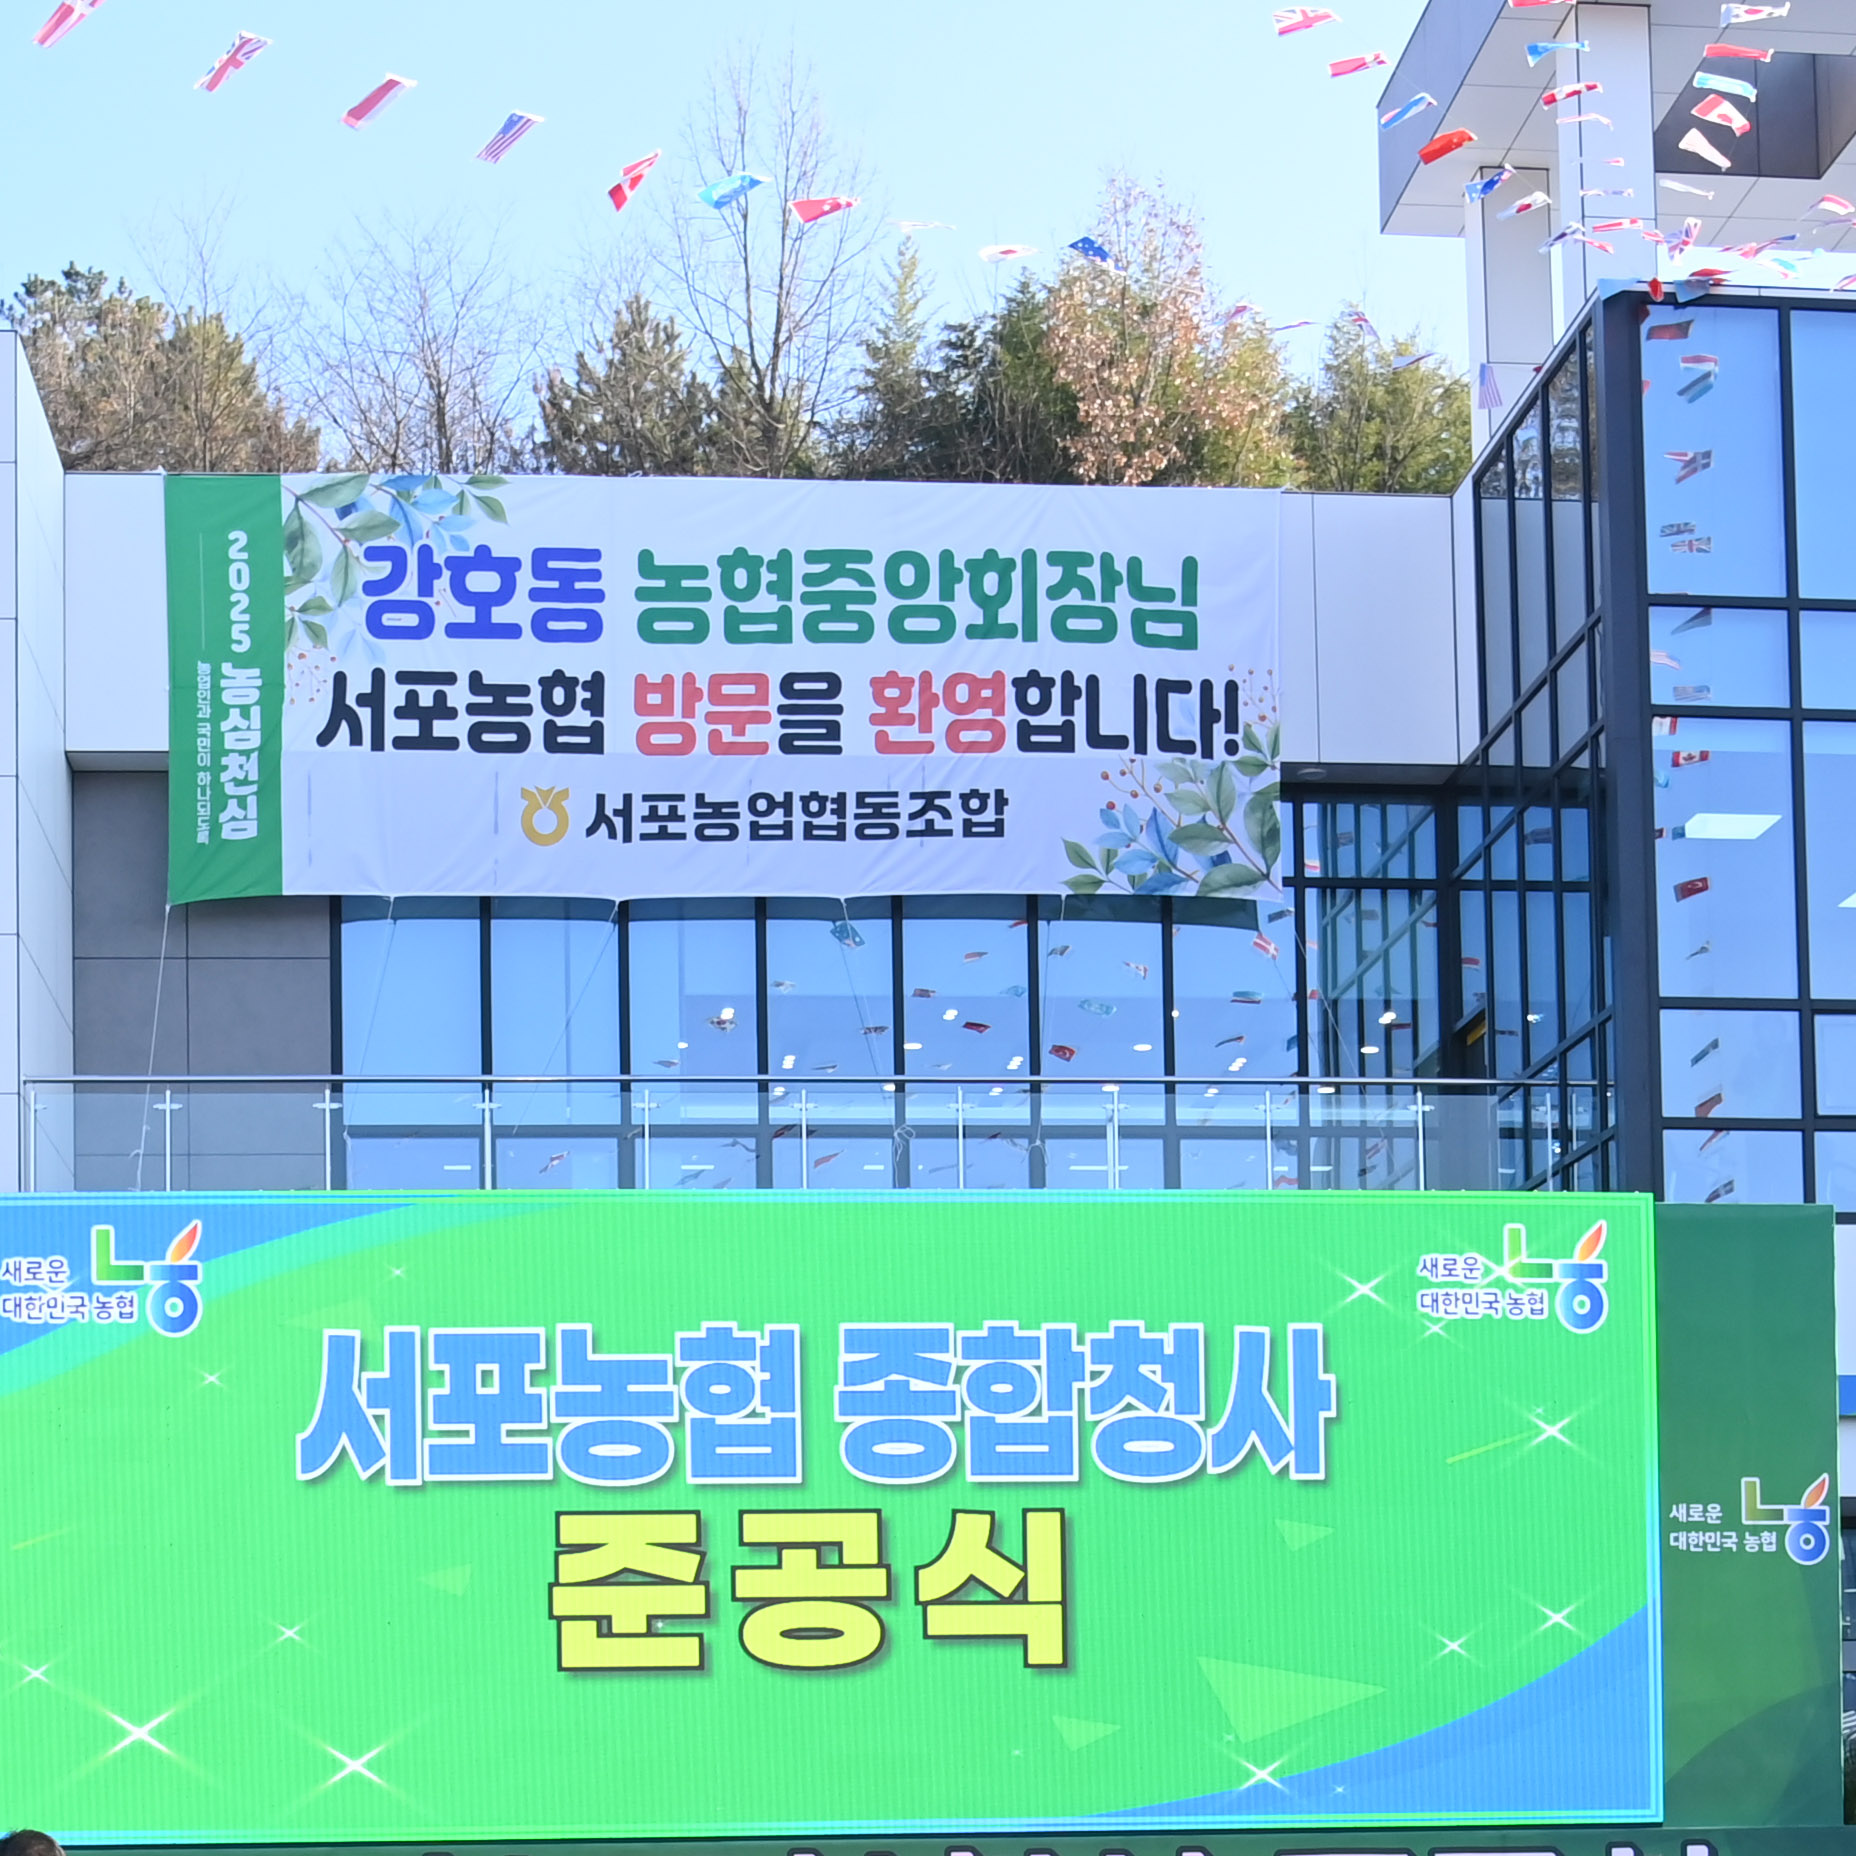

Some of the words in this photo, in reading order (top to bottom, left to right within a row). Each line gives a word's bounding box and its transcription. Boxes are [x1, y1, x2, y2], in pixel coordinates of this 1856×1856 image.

[228, 530, 252, 653] 2025
[363, 545, 605, 642] 강호동
[635, 546, 1200, 651] 농협중앙회장님
[316, 671, 605, 756] 서포농협
[632, 671, 844, 757] 방문을
[868, 671, 1242, 758] 환영합니다!
[218, 662, 263, 840] 농심천심
[587, 790, 1009, 844] 서포농업협동조합
[0, 1257, 70, 1284] 새로운
[1418, 1256, 1482, 1280] 새로운
[0, 1293, 89, 1321] 대한민국
[92, 1293, 137, 1321] 농협
[1419, 1291, 1501, 1316] 대한민국
[1505, 1291, 1546, 1316] 농협
[295, 1319, 803, 1488] 서포농협
[834, 1319, 1337, 1485] 종합청사
[1669, 1502, 1723, 1524] 새로운
[1669, 1531, 1739, 1552] 대한민국
[1743, 1530, 1777, 1553] 농협
[548, 1507, 1070, 1672] 준공식
